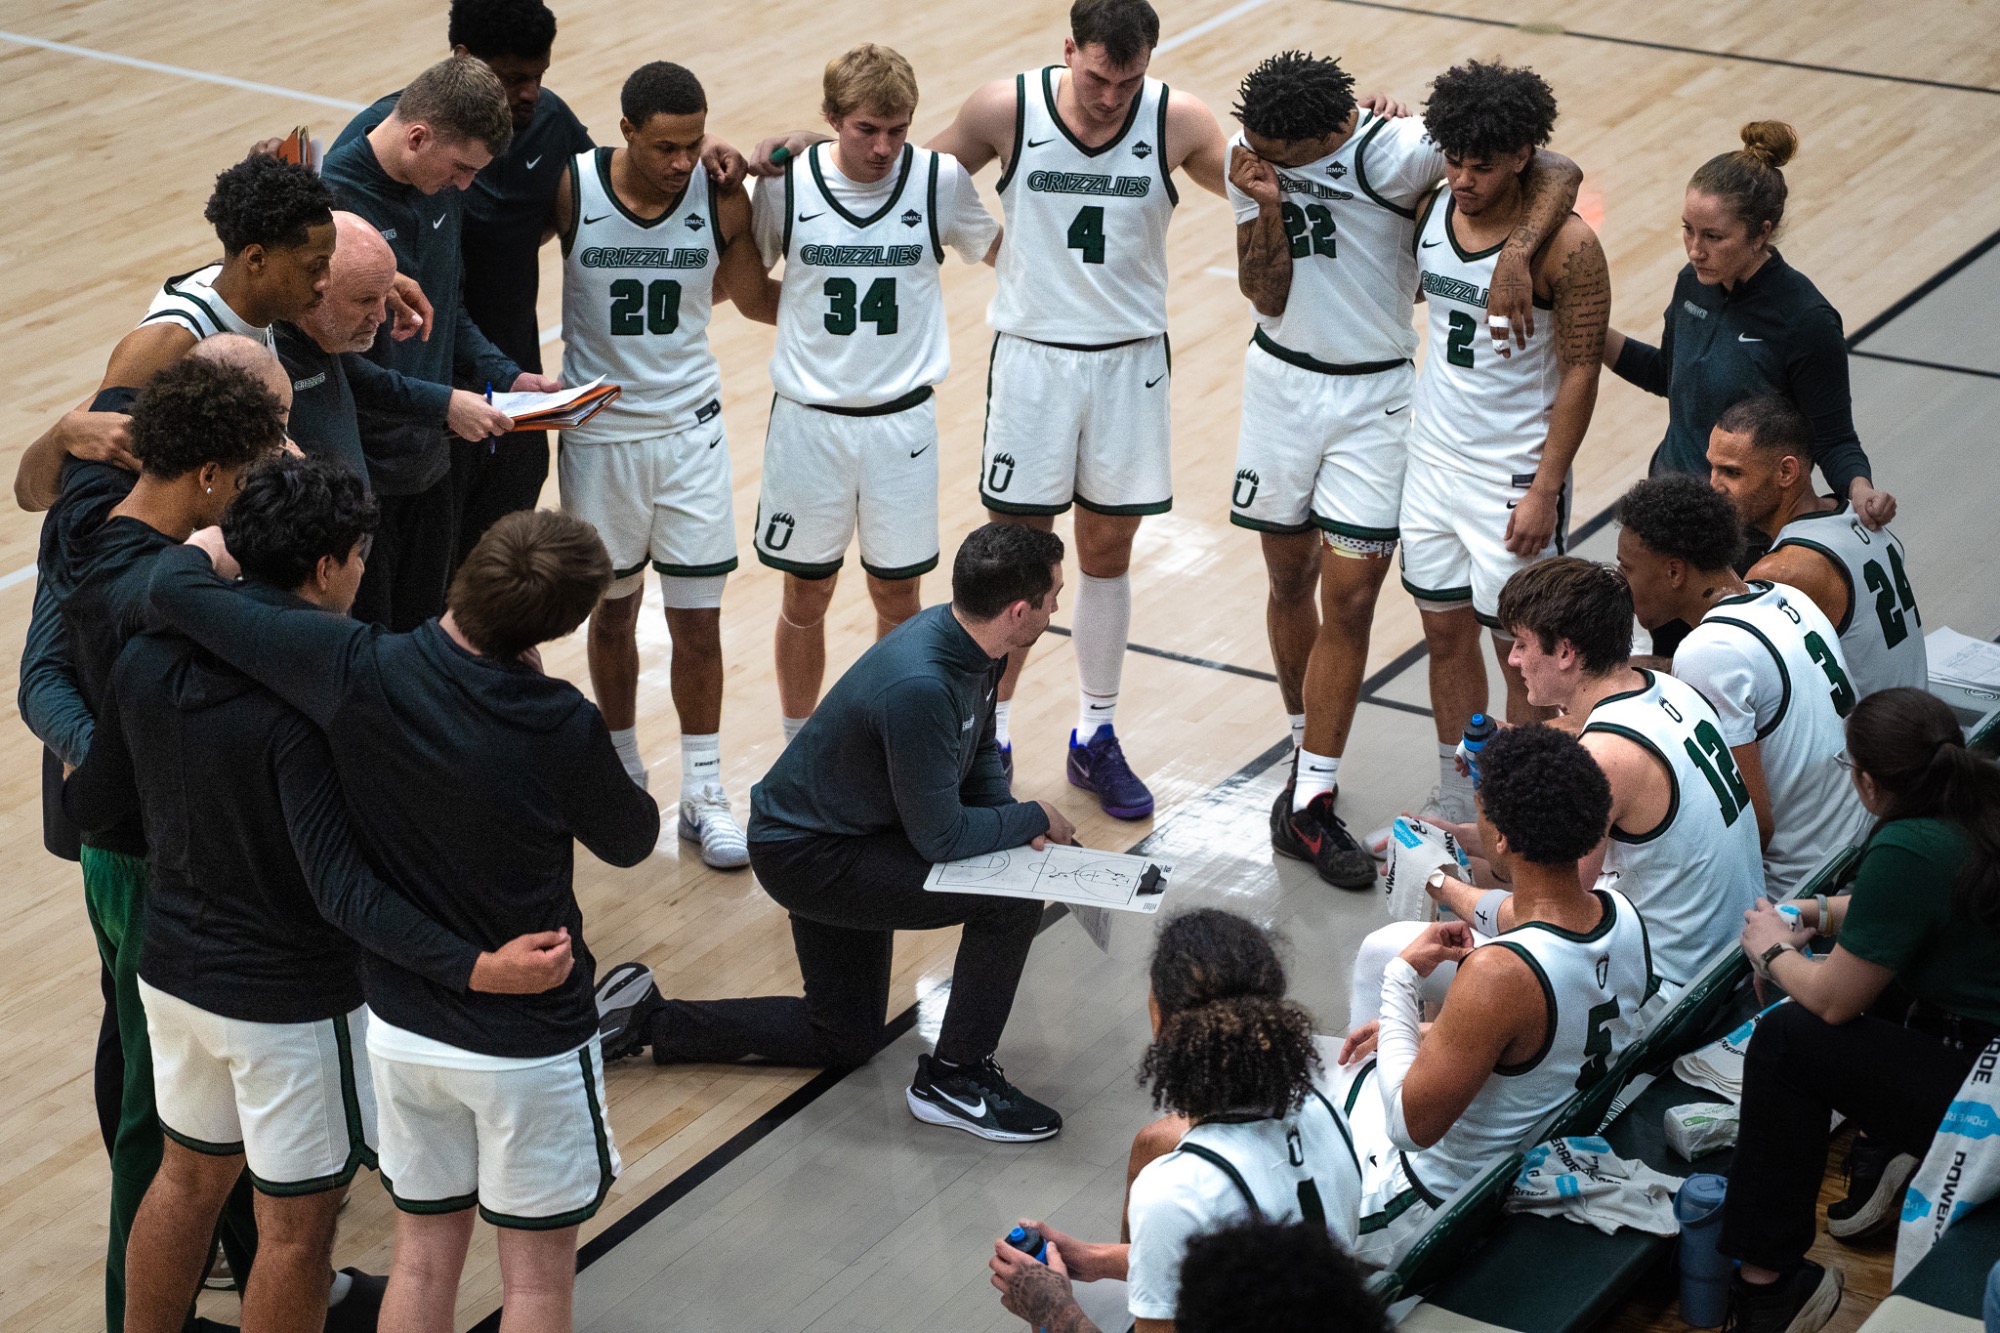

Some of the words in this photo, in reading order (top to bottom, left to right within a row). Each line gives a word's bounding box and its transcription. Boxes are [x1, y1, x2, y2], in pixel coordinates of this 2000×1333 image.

[1027, 170, 1151, 198] GRIZZLIES
[580, 247, 709, 269] GRIZZLIES
[800, 244, 923, 267] GRIZZLIES
[1067, 205, 1106, 264] 4
[1282, 201, 1337, 259] 22
[610, 278, 682, 336] 20
[824, 277, 898, 335] 34
[1421, 270, 1489, 309] GRIZZLI
[1447, 309, 1476, 368] 2
[1863, 543, 1921, 650] 24
[1804, 630, 1856, 719] 3
[1683, 719, 1750, 828] 12
[1575, 995, 1620, 1090] 5
